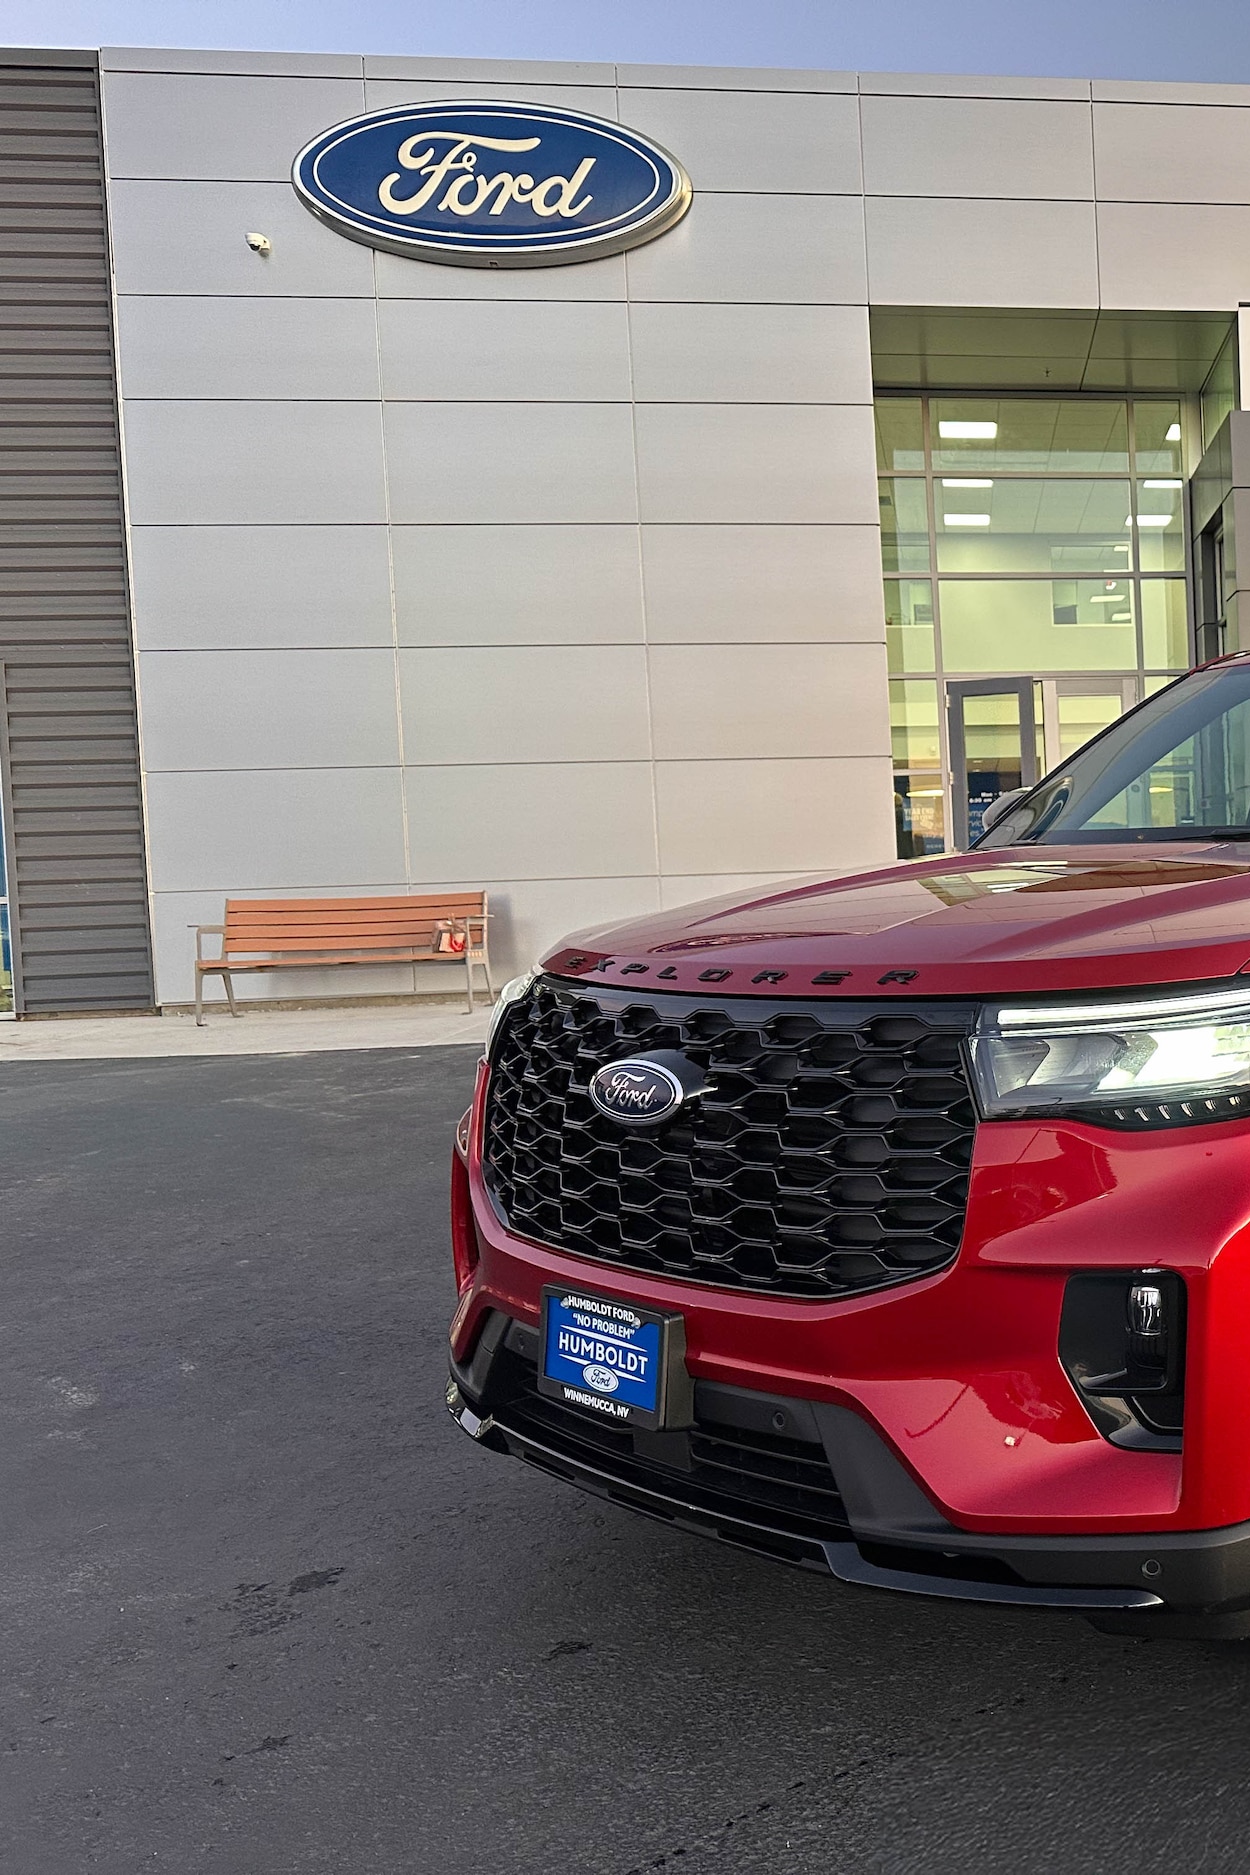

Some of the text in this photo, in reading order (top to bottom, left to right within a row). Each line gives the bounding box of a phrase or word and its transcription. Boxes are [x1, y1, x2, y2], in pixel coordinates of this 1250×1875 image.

[378, 131, 597, 218] Ford
[563, 955, 921, 986] EXPLORER
[604, 1071, 658, 1110] Ford
[568, 1295, 635, 1322] HUMBOLDT FORD
[559, 1332, 648, 1375] HUMBOLDT
[590, 1368, 612, 1388] Ford
[564, 1388, 629, 1418] WINNEMUCCA, NV
